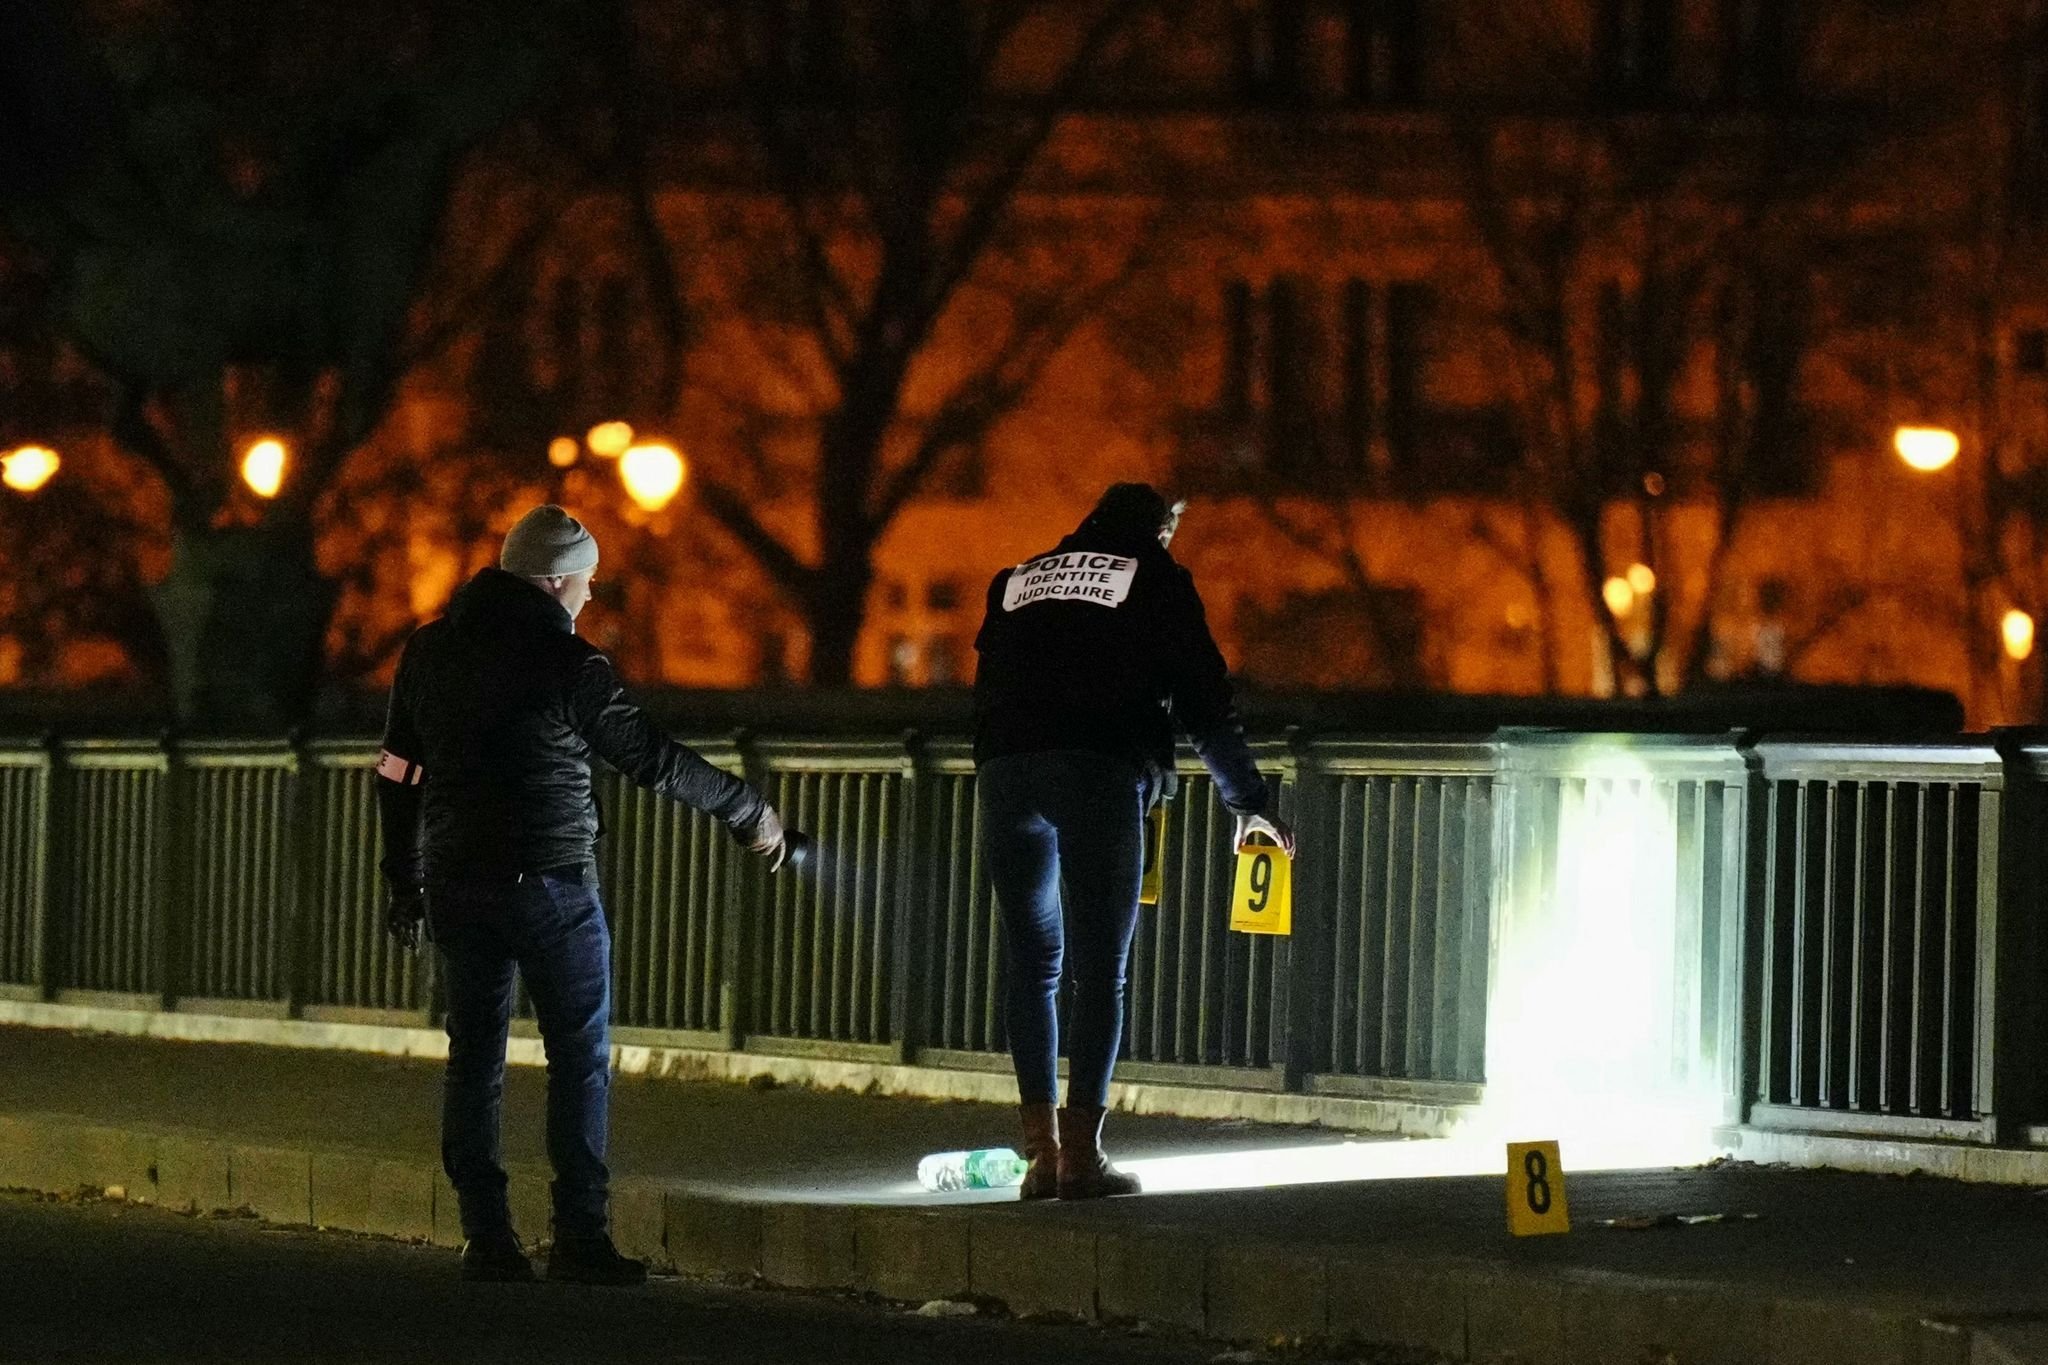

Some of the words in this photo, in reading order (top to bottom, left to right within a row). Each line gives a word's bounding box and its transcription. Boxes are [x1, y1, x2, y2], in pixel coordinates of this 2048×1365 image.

[1020, 555, 1130, 576] POLICE
[1024, 572, 1112, 587] IDENTITE
[1013, 585, 1115, 605] JUDICIAIRE
[1248, 853, 1272, 912] 9
[1525, 1150, 1551, 1215] 8
